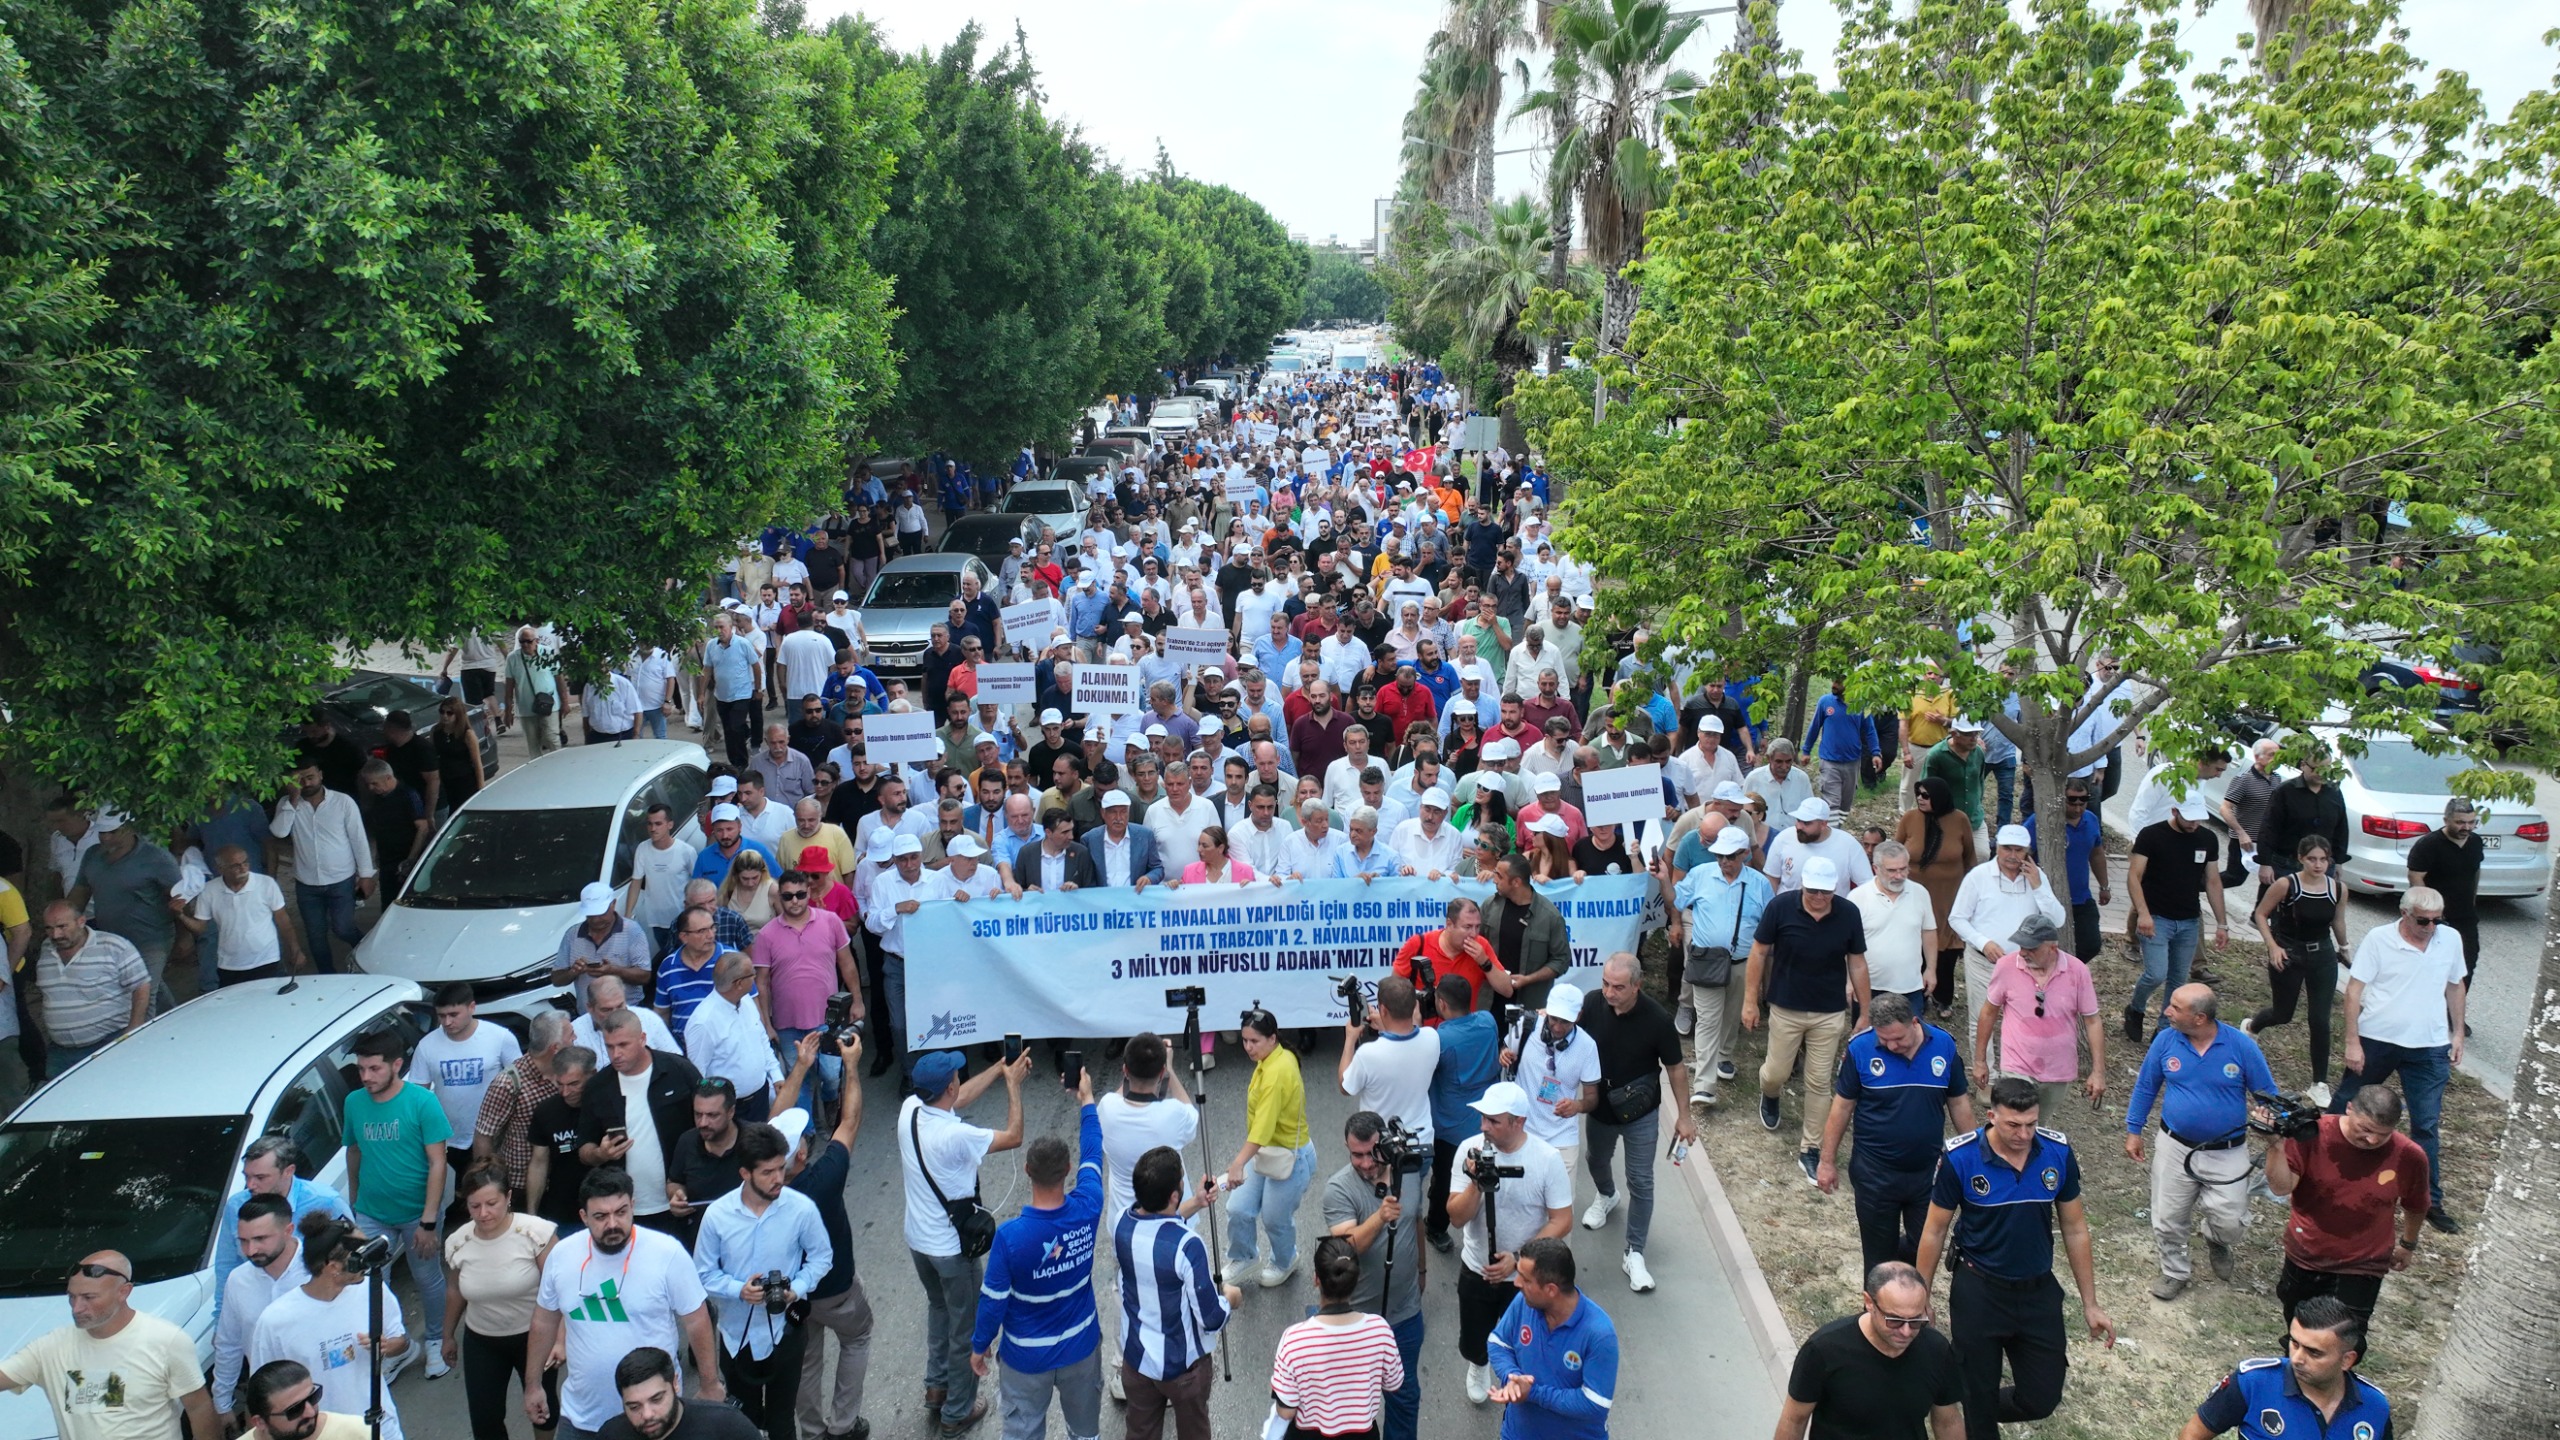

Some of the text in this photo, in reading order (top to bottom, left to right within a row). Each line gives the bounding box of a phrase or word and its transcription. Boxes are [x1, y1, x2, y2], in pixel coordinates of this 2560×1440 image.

[1081, 671, 1128, 686] ALANIMA
[1077, 689, 1128, 704] DOKUNMA
[1587, 787, 1659, 803] Adanalı bunu unutmaz
[972, 919, 1001, 938] 350
[1005, 914, 1029, 936] BİN
[1034, 912, 1098, 934] NÜFUSLU
[1103, 909, 1156, 930] RİZE'YE
[1161, 907, 1241, 928] HAVAALANI
[1246, 900, 1315, 923] YAPILDIĞI
[1319, 899, 1348, 926] İÇİN
[1353, 901, 1382, 919] 850
[1387, 898, 1411, 919] BİN
[1160, 933, 1205, 951] HATTA
[1210, 928, 1289, 950] TRABZON'A
[1293, 929, 1308, 946] 2.
[1313, 925, 1392, 944] HAVAALANI
[1111, 960, 1123, 980] 3
[1128, 953, 1191, 978] MİLYON
[1198, 950, 1270, 974] NÜFUSLU
[1276, 948, 1374, 971] ADANA'MIZI
[953, 1014, 976, 1023] BÜYÜK
[956, 1021, 977, 1030] ŞEHİR
[952, 1028, 977, 1037] ADANA
[442, 1060, 482, 1080] LOFT
[1062, 1224, 1092, 1242] BÜYÜK
[1068, 1232, 1093, 1250] ŞEHİR
[1065, 1241, 1093, 1259] ADANA
[1032, 1261, 1075, 1280] İLAÇLAMA
